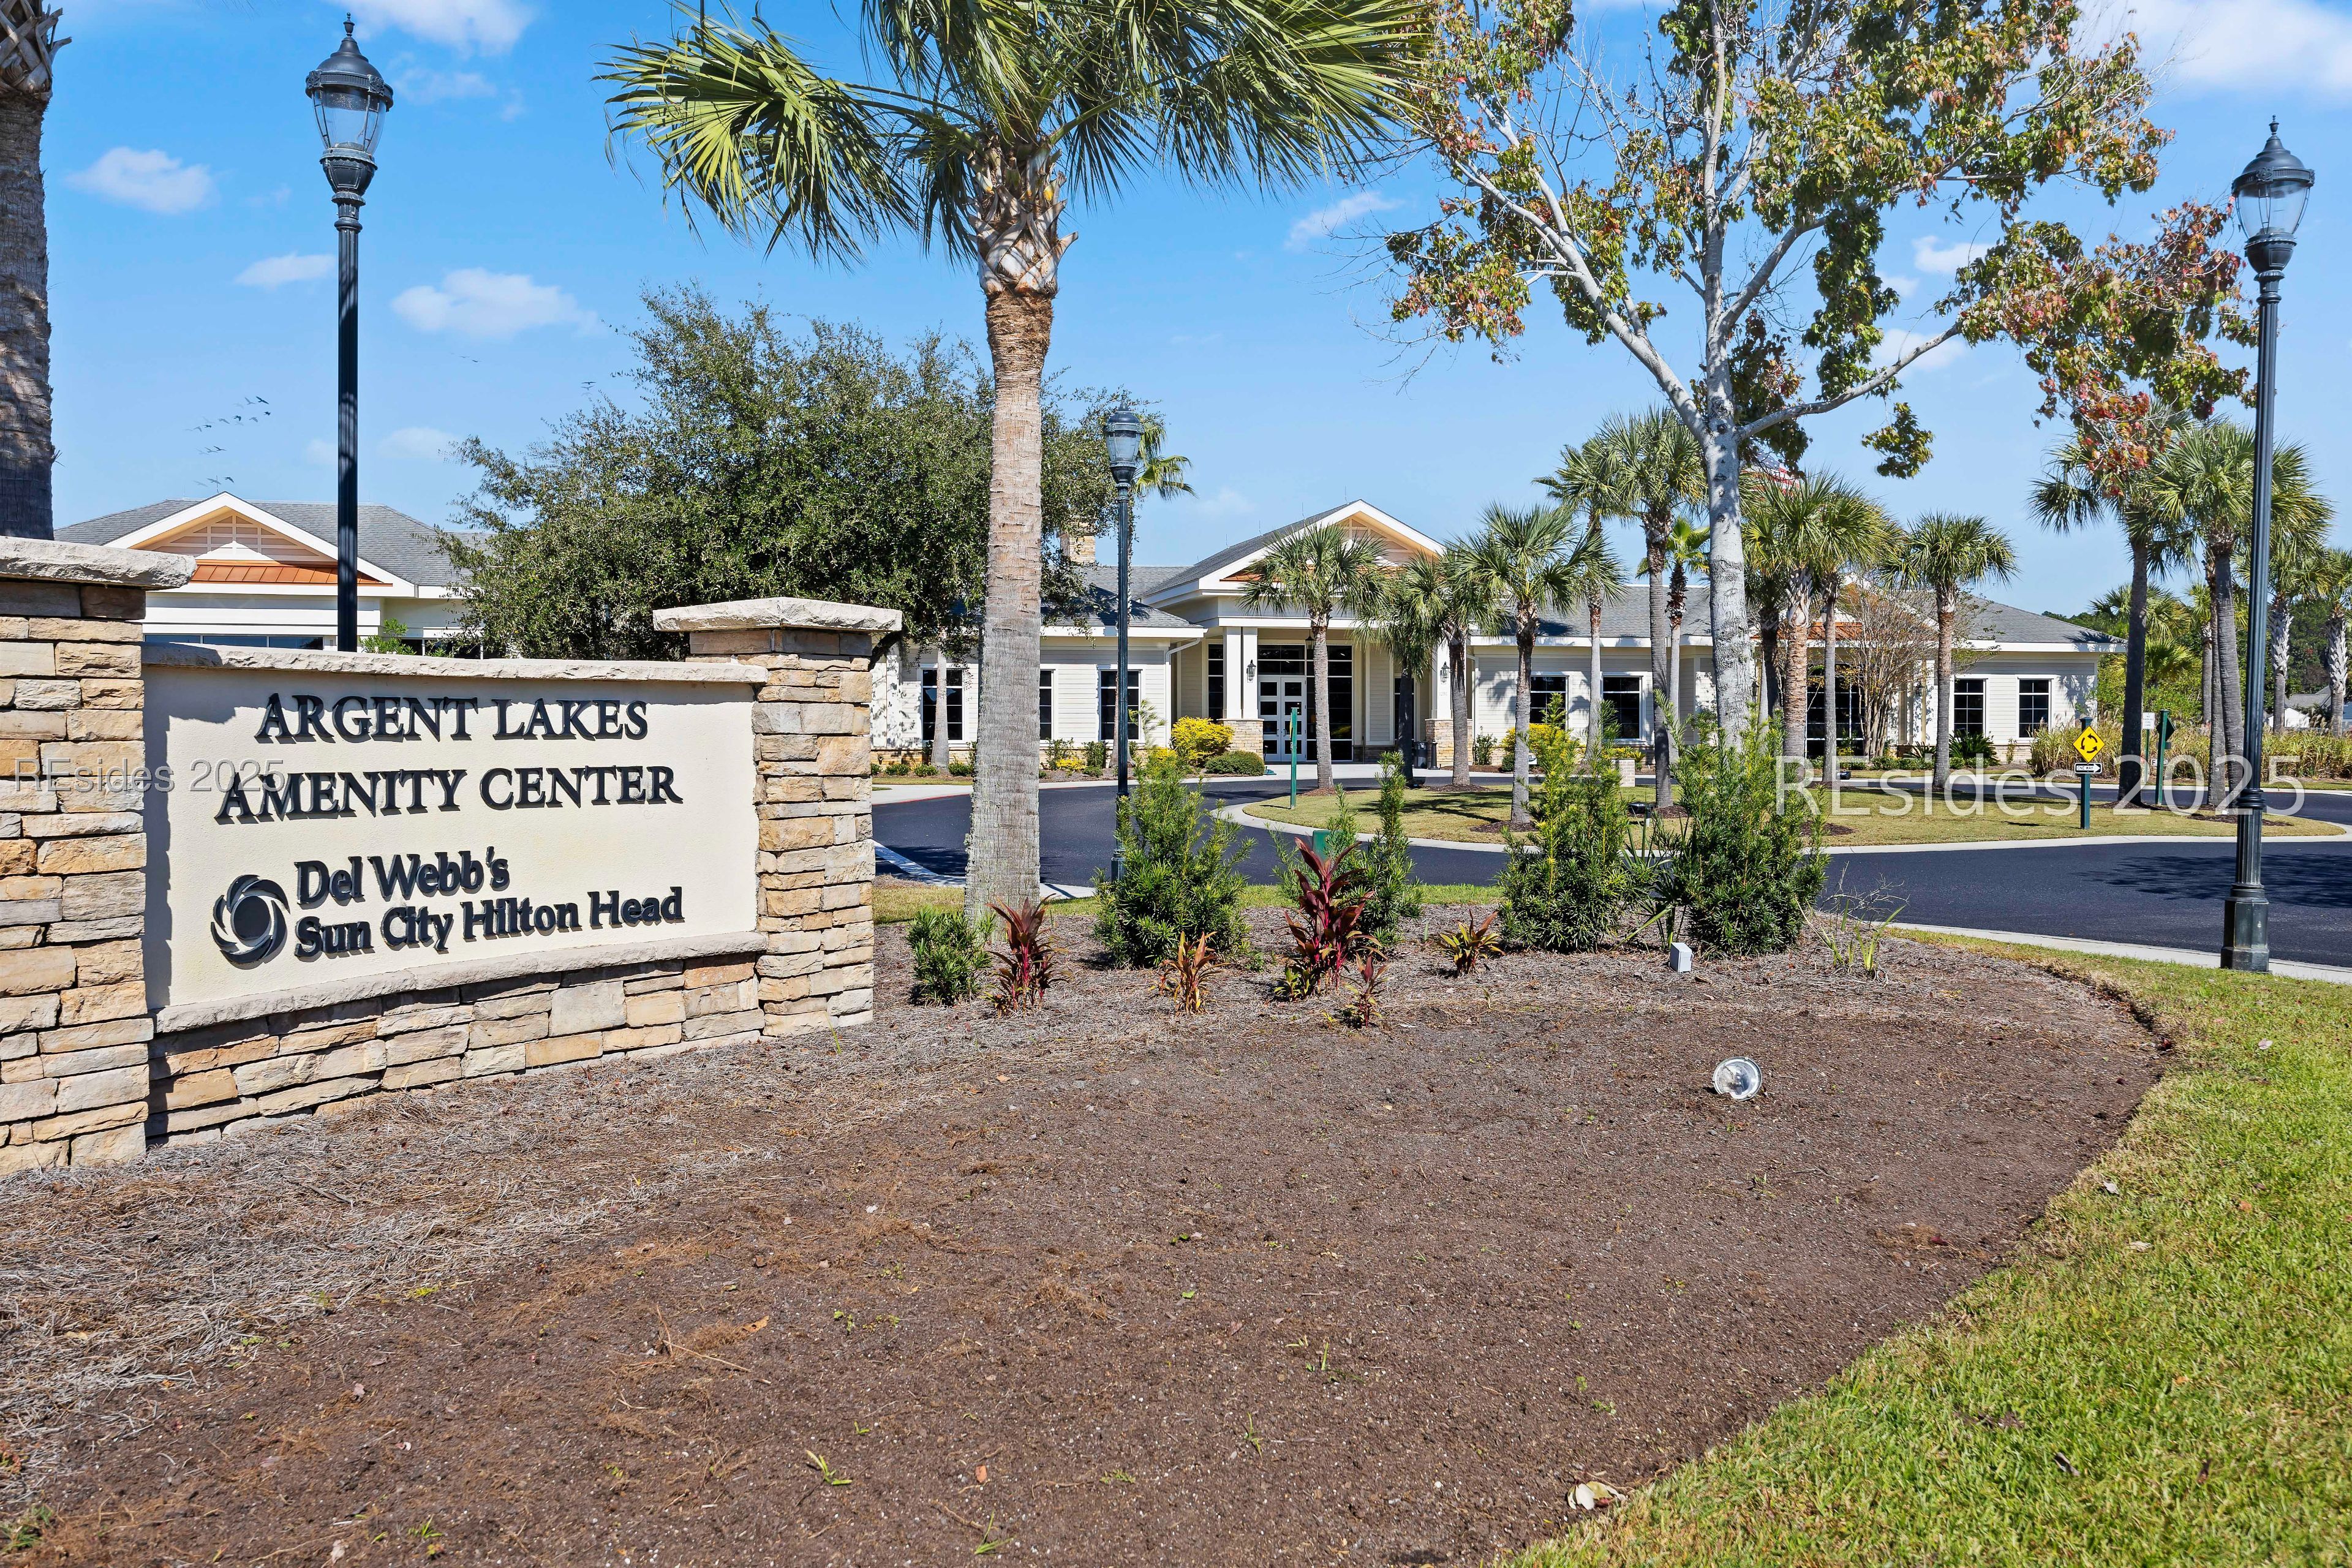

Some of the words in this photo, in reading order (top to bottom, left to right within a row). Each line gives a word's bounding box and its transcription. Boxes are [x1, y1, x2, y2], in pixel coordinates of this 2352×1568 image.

[255, 693, 478, 742] ARGENT
[491, 698, 647, 741] LAKES
[214, 767, 468, 821] AMENITY
[480, 765, 684, 810] CENTER
[294, 856, 365, 907] Del
[367, 846, 510, 901] Webb's
[294, 916, 375, 960] Sun
[380, 906, 453, 952] City
[460, 897, 582, 941] Hilton
[587, 886, 685, 927] Head
